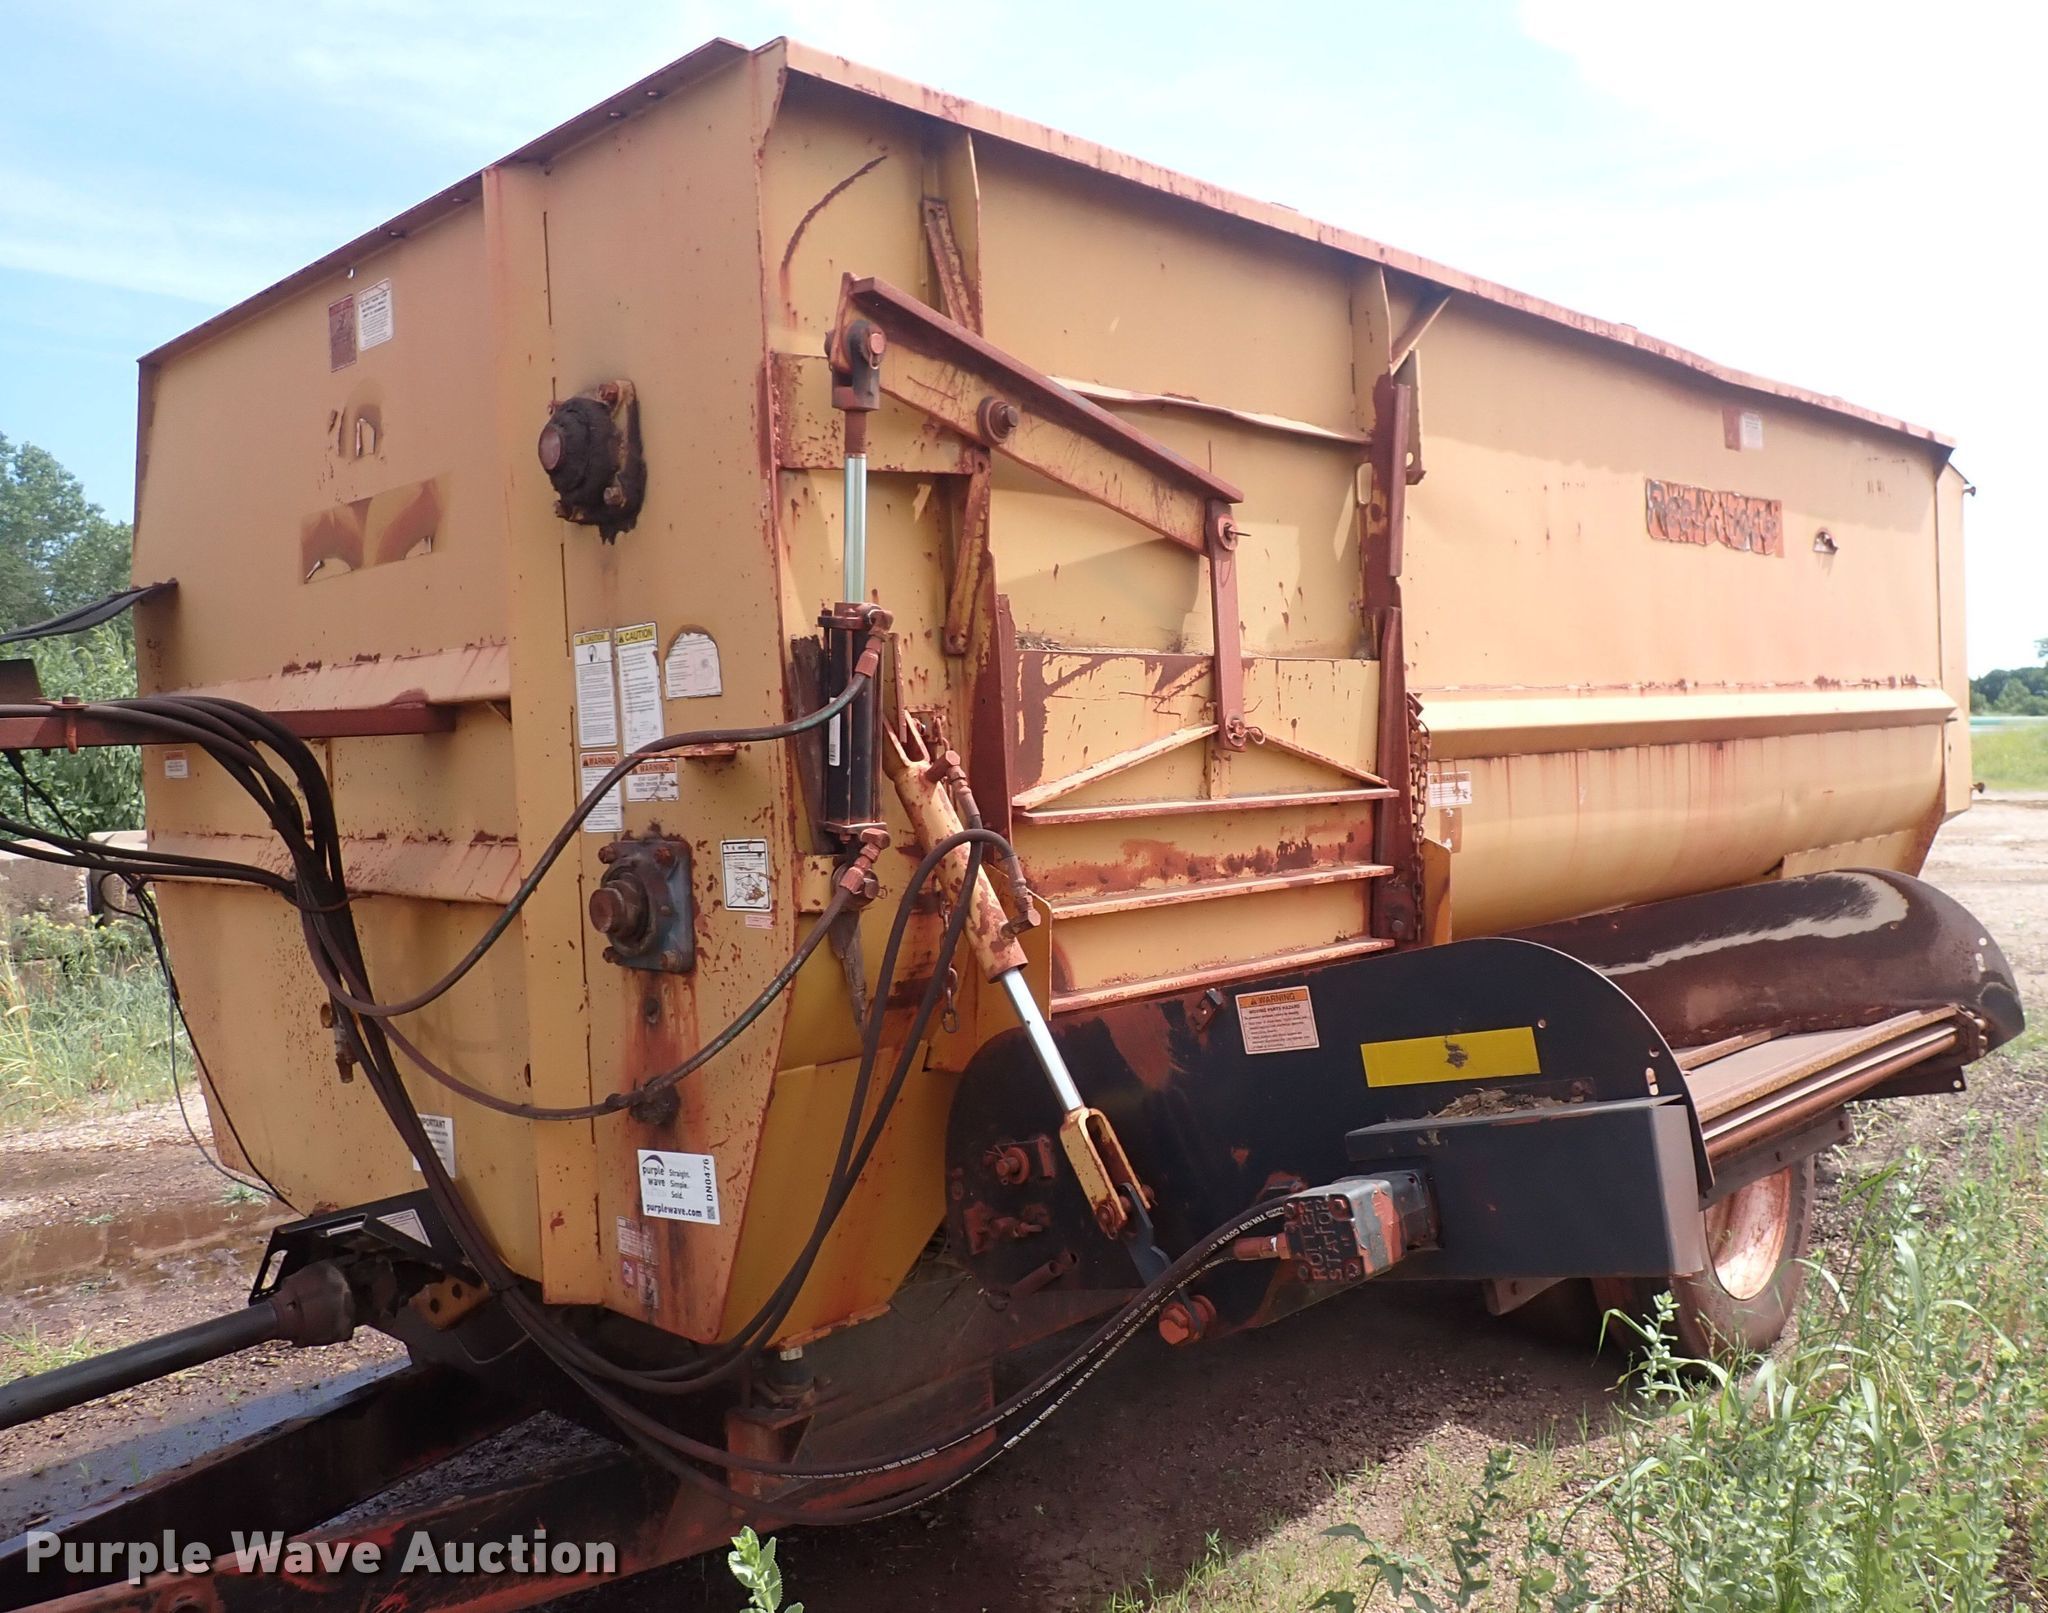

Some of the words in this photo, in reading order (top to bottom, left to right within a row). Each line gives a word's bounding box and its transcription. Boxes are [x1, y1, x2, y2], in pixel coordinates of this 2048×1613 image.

[625, 628, 653, 641] CAUTION
[588, 756, 617, 766] WARNING
[639, 763, 669, 773] WARNING
[1260, 992, 1295, 1004] WARNING
[421, 1117, 445, 1128] PORTANT
[642, 1165, 665, 1177] purple
[648, 1178, 666, 1187] wave
[646, 1203, 702, 1218] purplewave.com
[1315, 1199, 1343, 1281] STATOR
